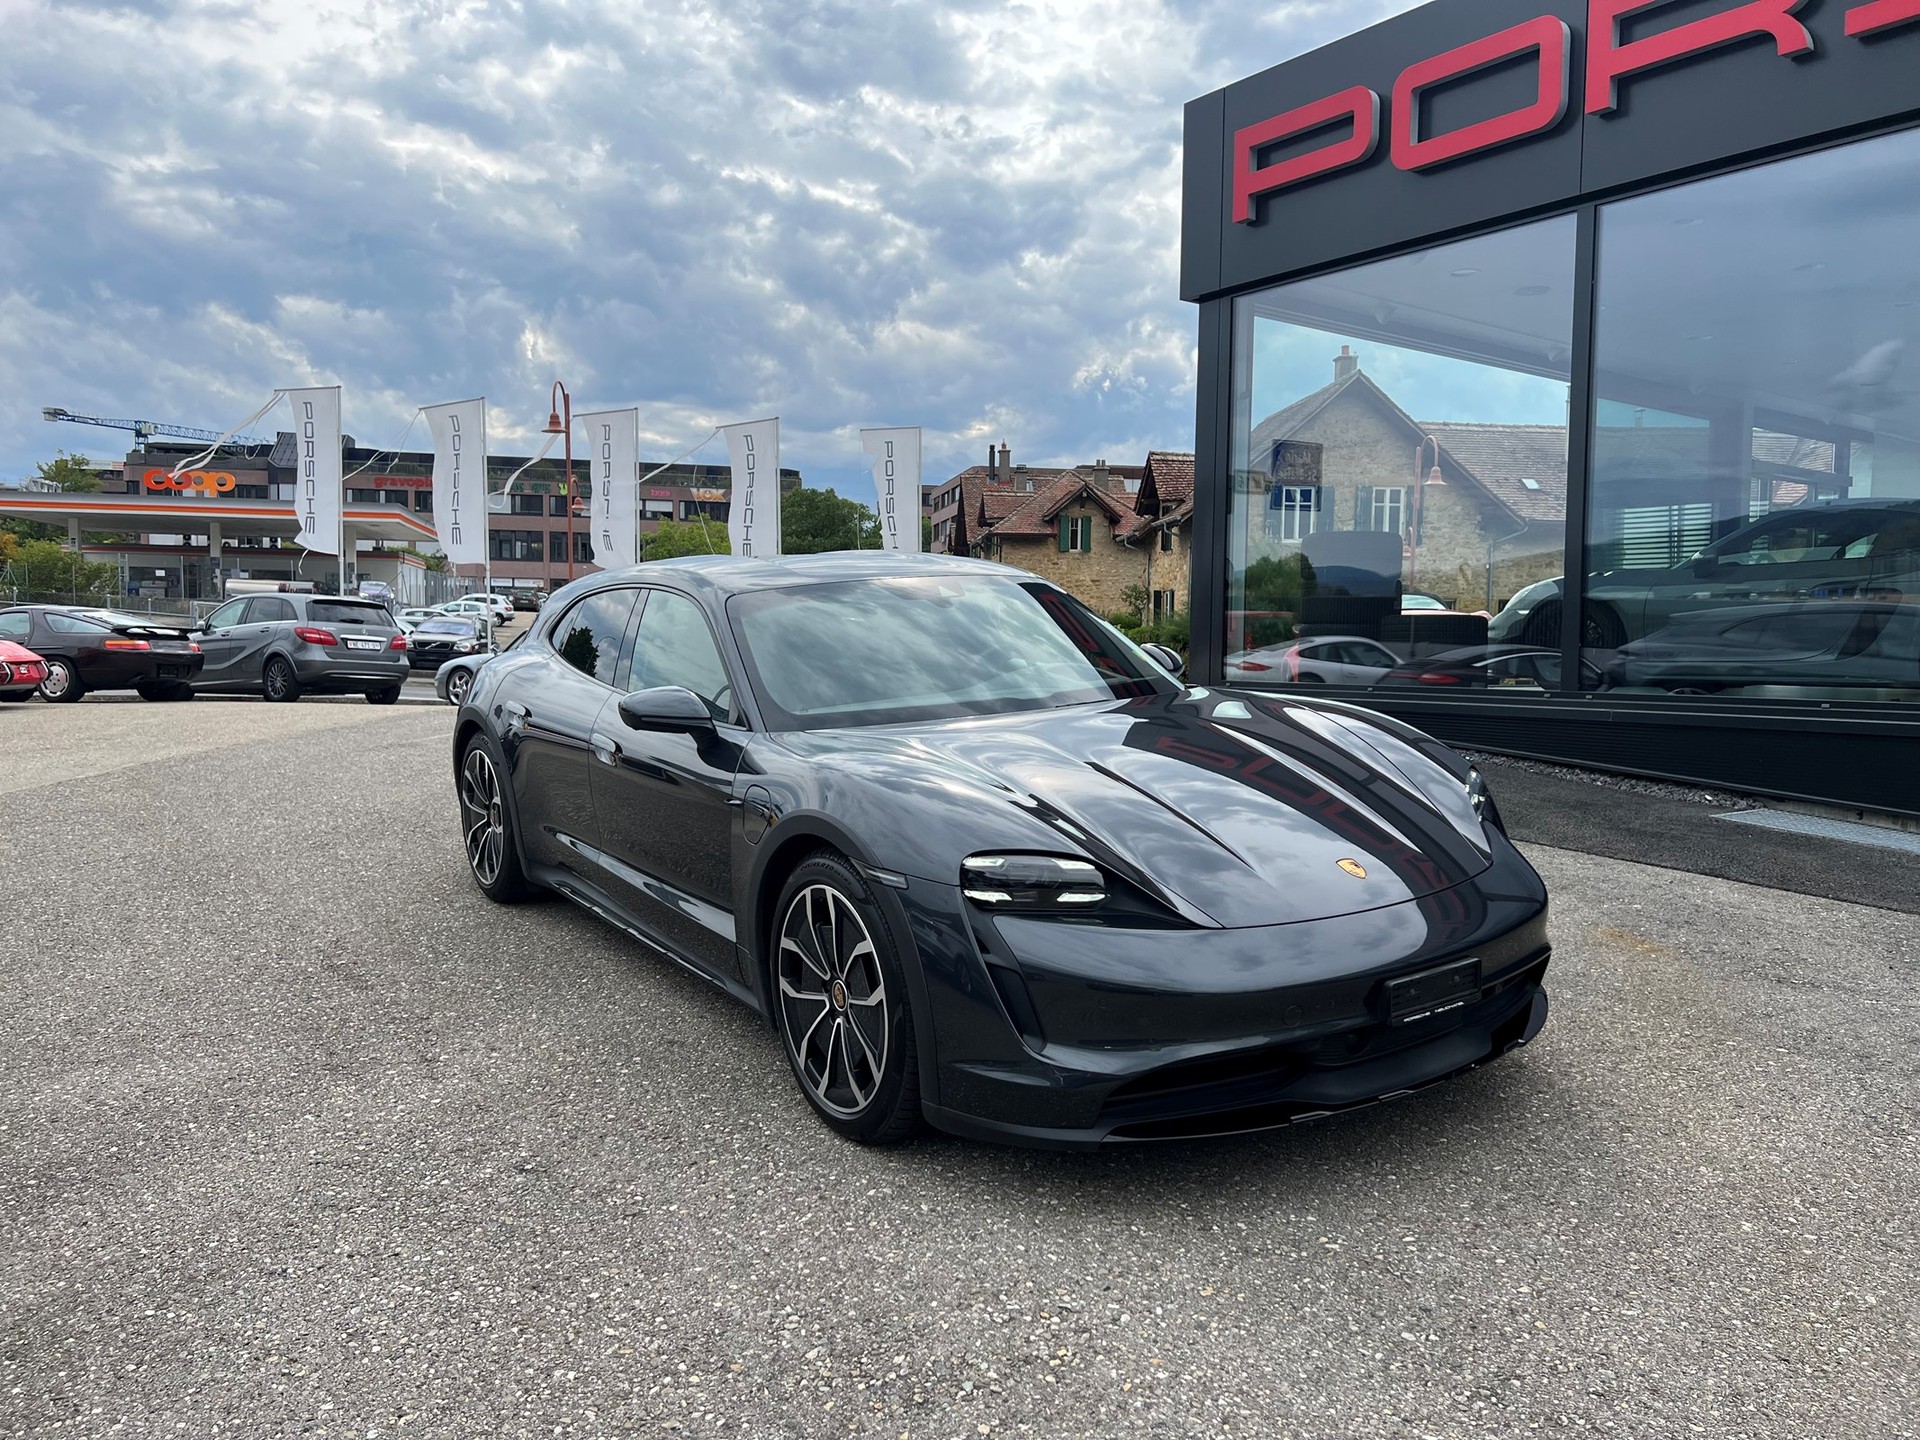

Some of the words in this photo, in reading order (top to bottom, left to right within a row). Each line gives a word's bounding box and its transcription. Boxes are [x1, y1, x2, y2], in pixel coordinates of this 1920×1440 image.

[144, 469, 236, 498] coop
[302, 401, 316, 535] PORSCHE
[742, 434, 756, 557] PORSCHE
